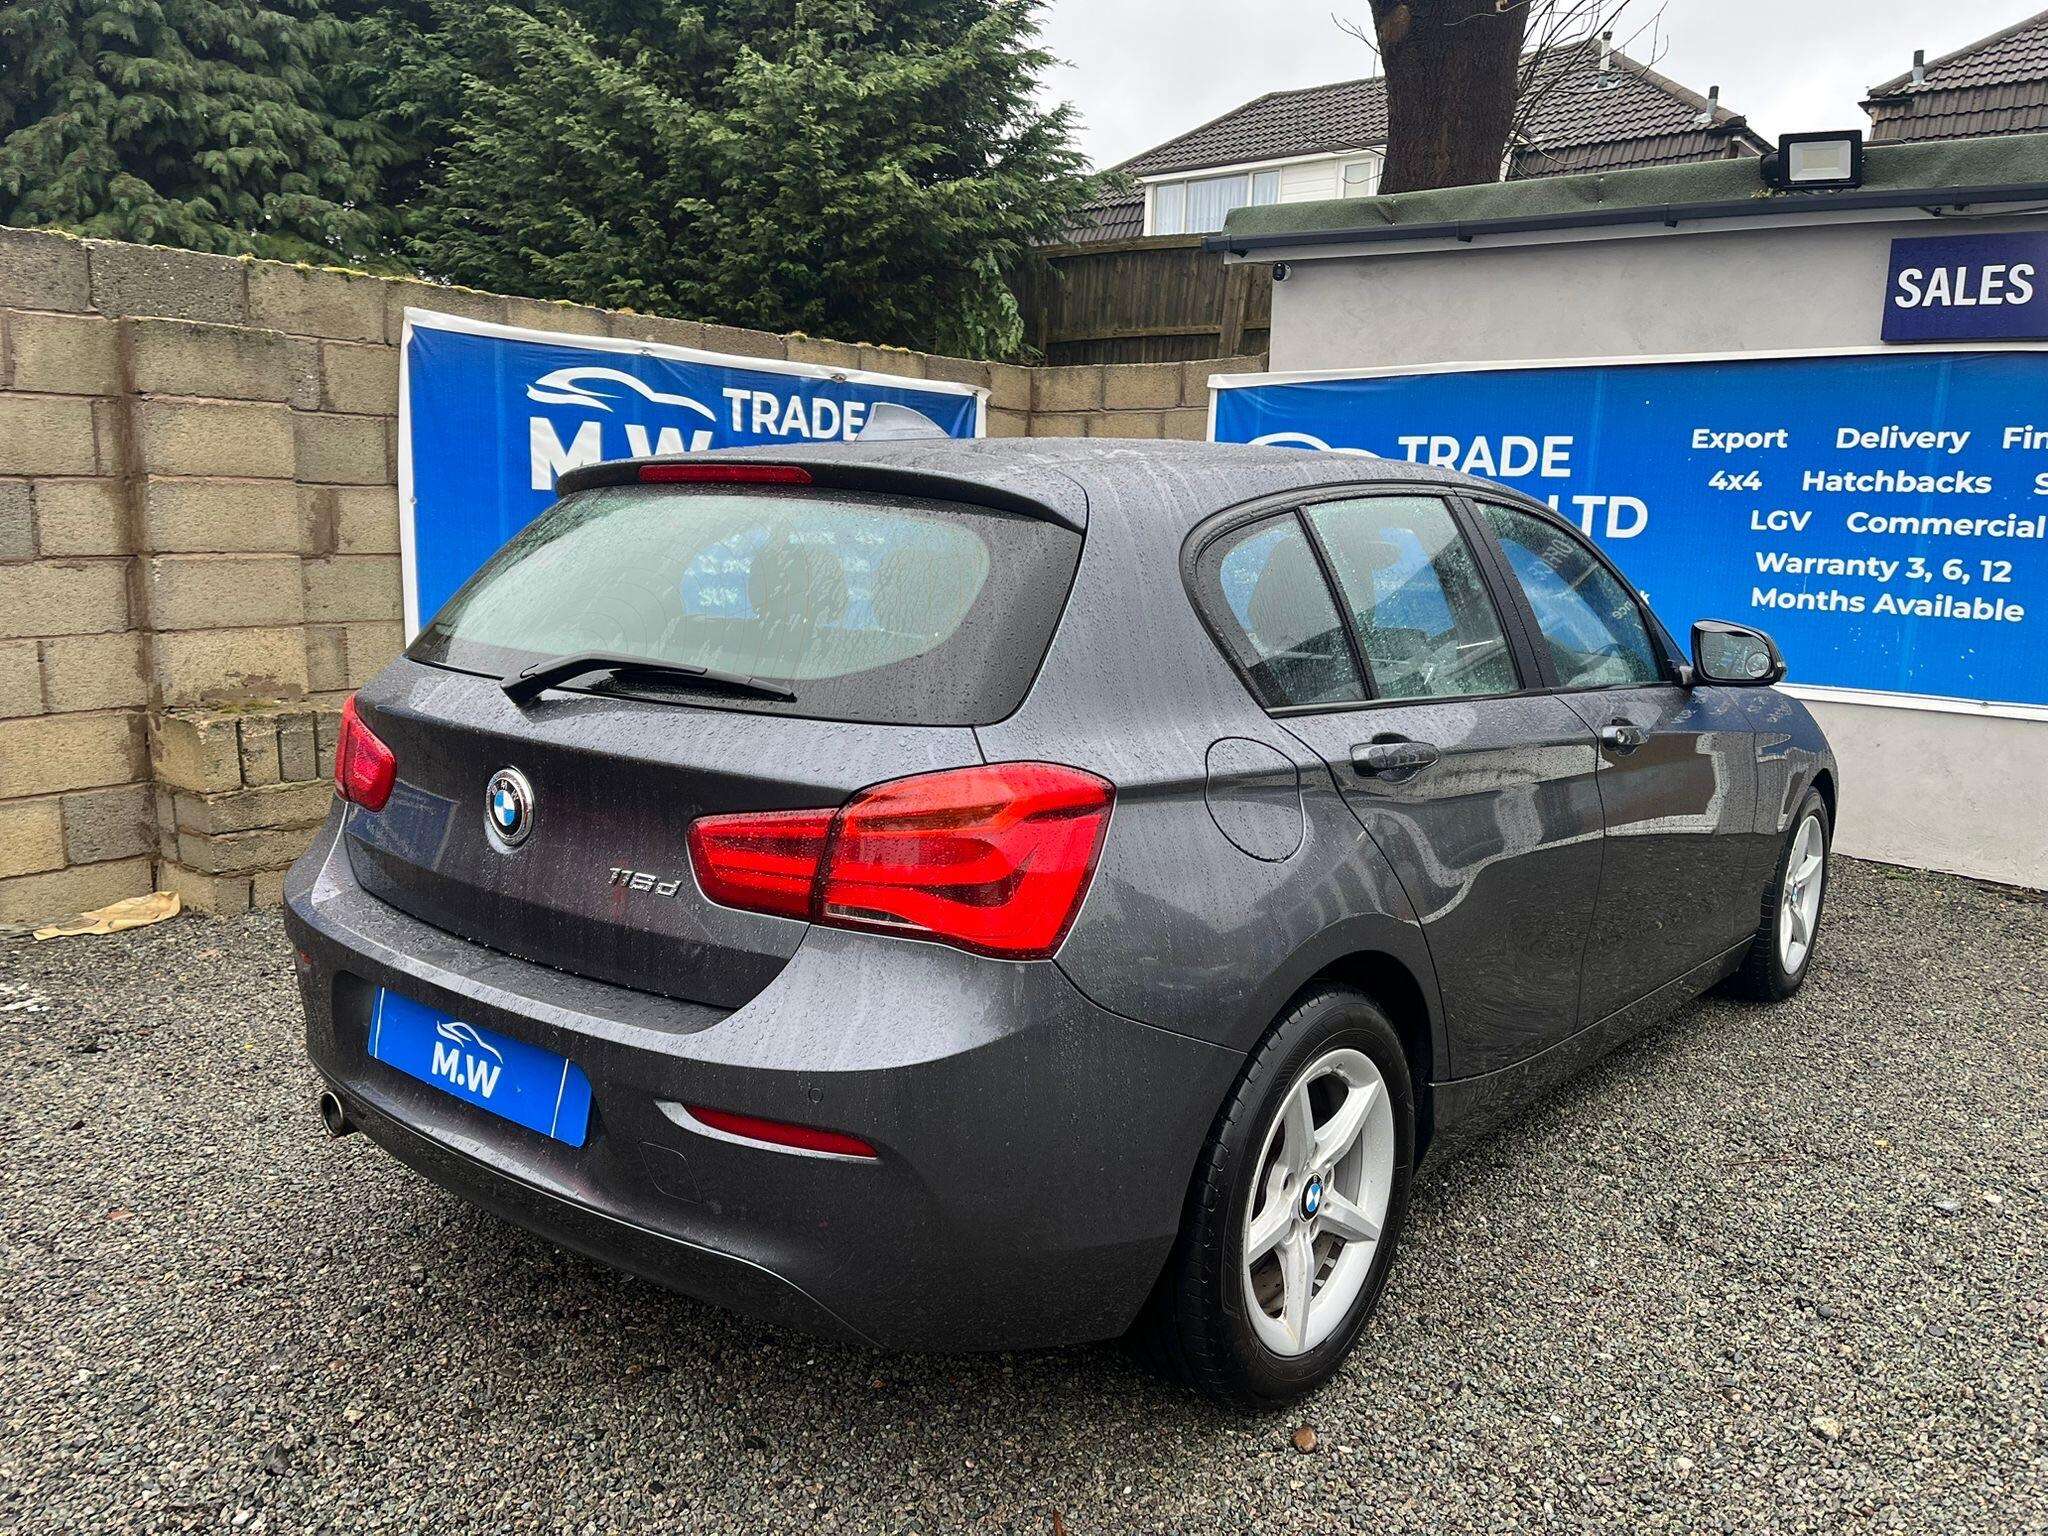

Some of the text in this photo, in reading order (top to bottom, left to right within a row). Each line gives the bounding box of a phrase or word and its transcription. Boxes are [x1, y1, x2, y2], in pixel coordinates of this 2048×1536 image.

[1895, 263, 2035, 308] SALES
[722, 387, 866, 441] TRADE
[1398, 435, 1574, 477] TRADE
[1691, 428, 1789, 454] Export
[1836, 424, 1971, 454] Delivery
[1708, 470, 1763, 491] 4x4
[1801, 470, 1993, 494] Hatchbacks
[1750, 509, 2046, 538] LGV Commercial
[1755, 551, 2012, 585] Warranty 3, 6, 12
[1750, 587, 2025, 622] Months Available
[431, 1041, 501, 1099] M.W
